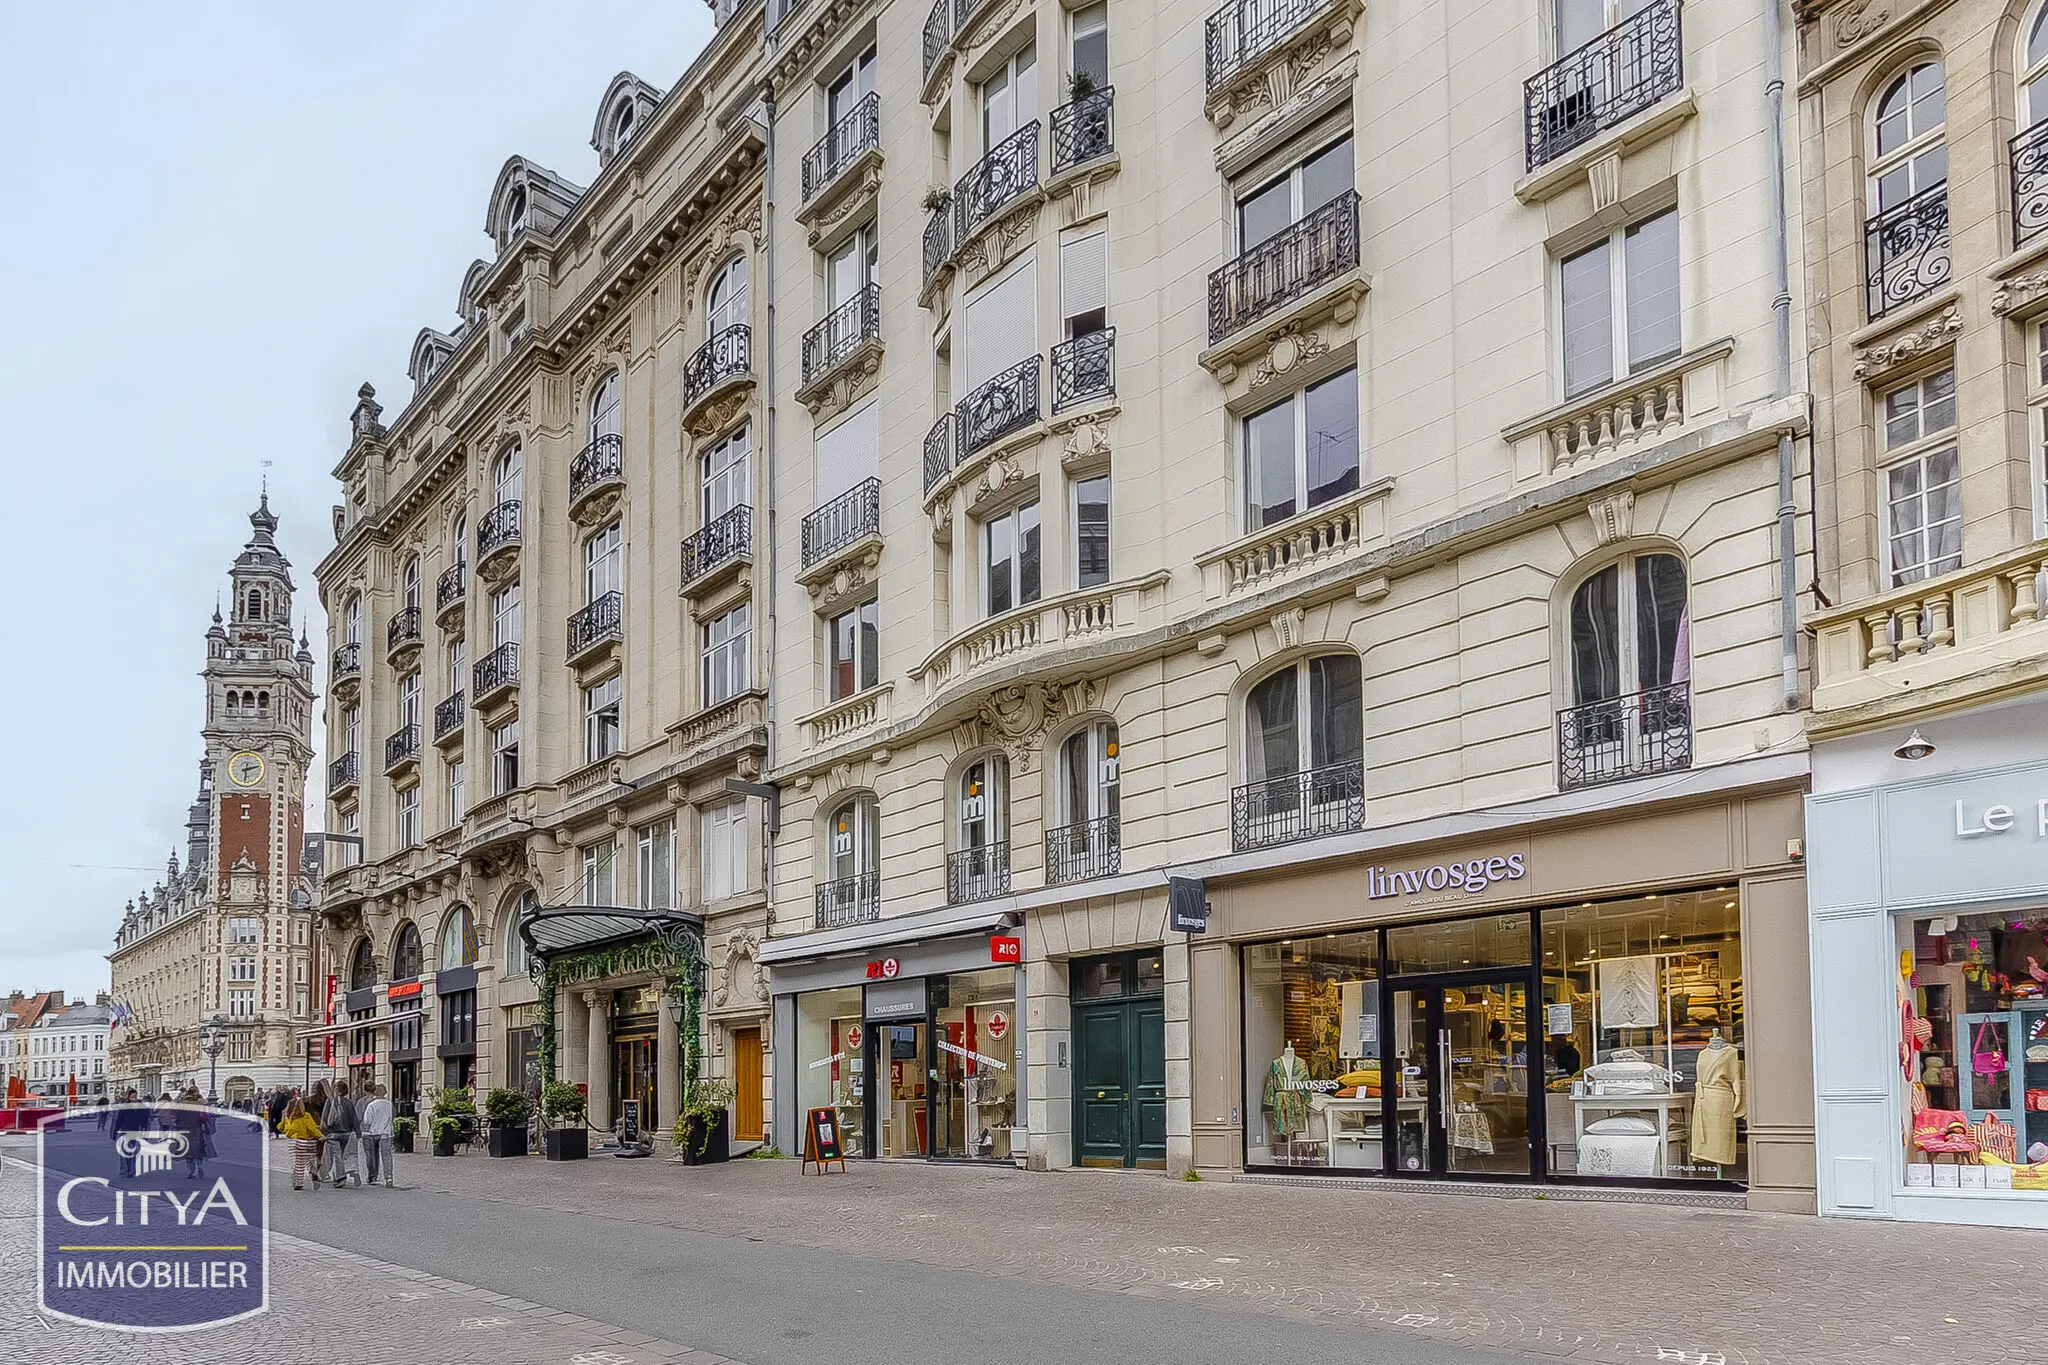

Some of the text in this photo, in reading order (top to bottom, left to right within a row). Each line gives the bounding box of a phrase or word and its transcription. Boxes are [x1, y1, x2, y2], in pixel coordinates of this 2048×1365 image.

[1956, 799, 2014, 835] Le
[1365, 853, 1526, 899] linvosges
[873, 1002, 914, 1014] CHAUSSURES
[1667, 1164, 1696, 1172] DEPUIS
